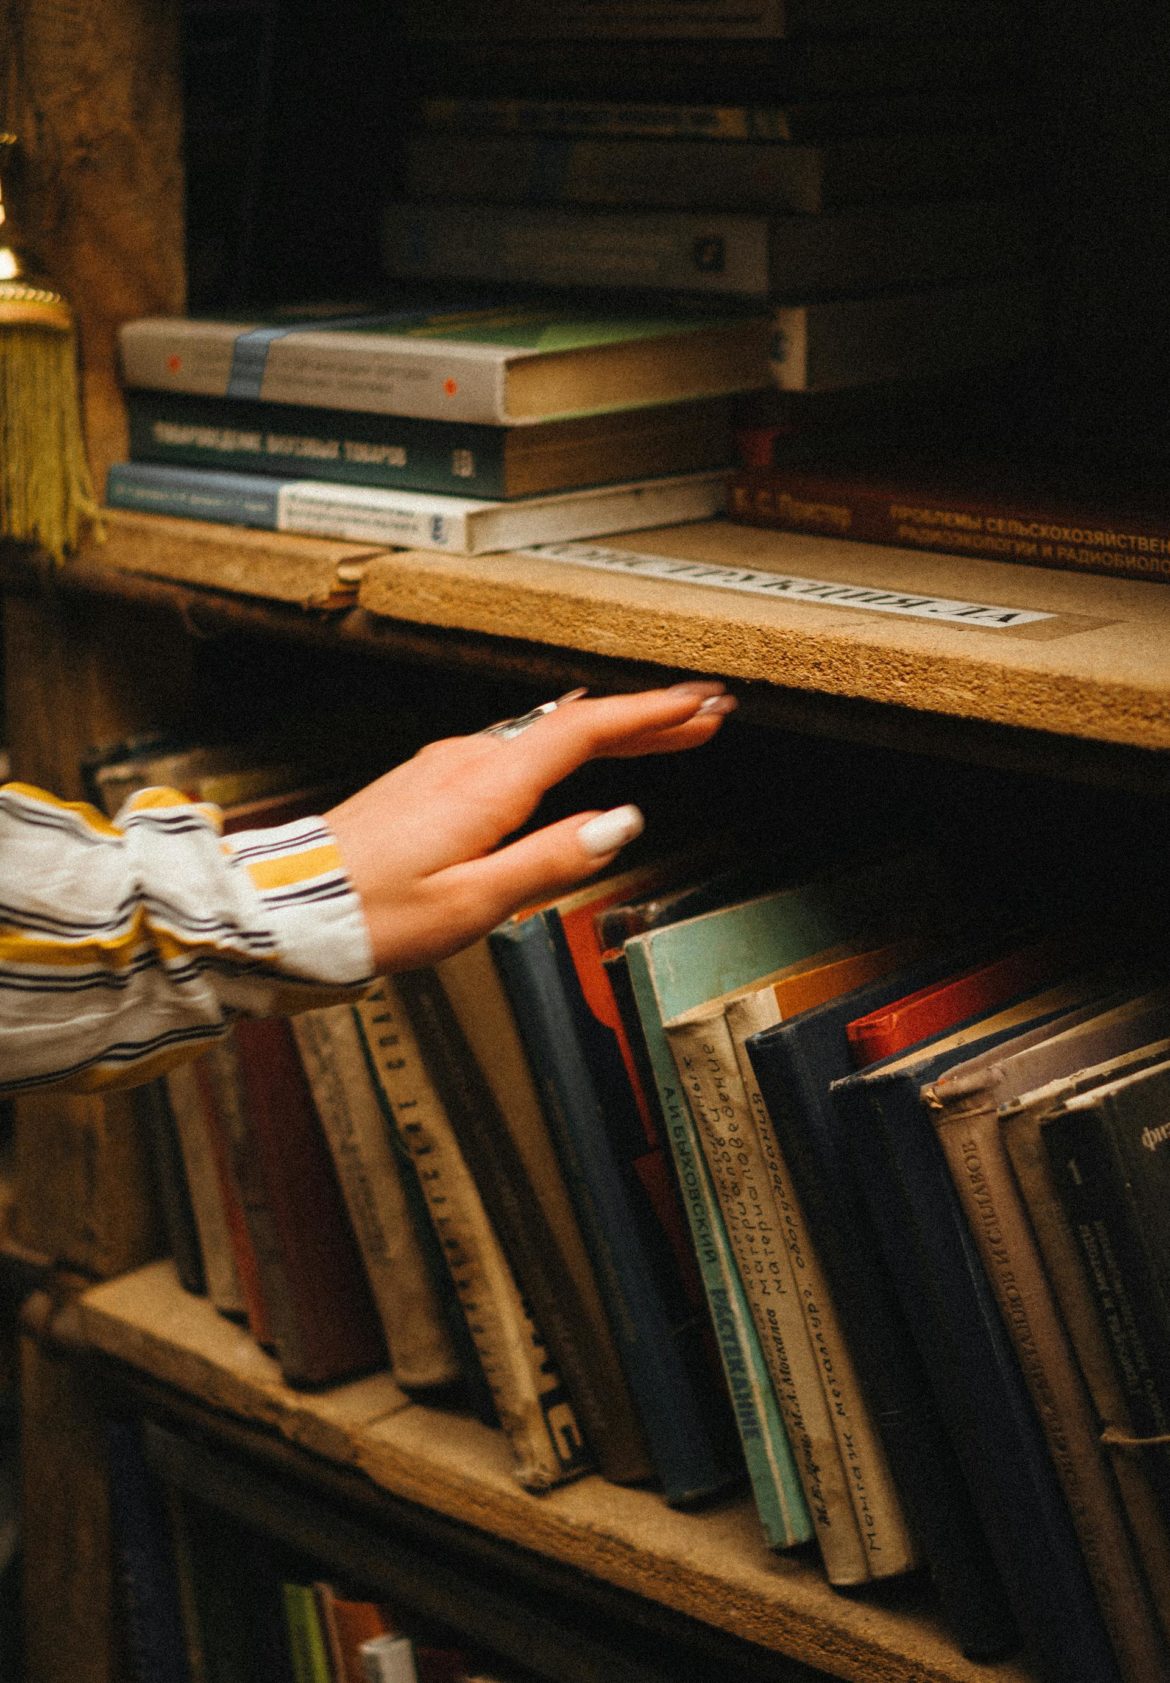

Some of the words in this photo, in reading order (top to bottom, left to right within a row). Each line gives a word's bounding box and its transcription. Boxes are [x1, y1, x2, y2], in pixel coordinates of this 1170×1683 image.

[889, 504, 982, 530] ПРОБЛЕМЫ
[702, 1043, 787, 1294] материаловедение
[961, 1139, 1003, 1244] СПЛАВОВ
[842, 1431, 882, 1551] Монтаж
